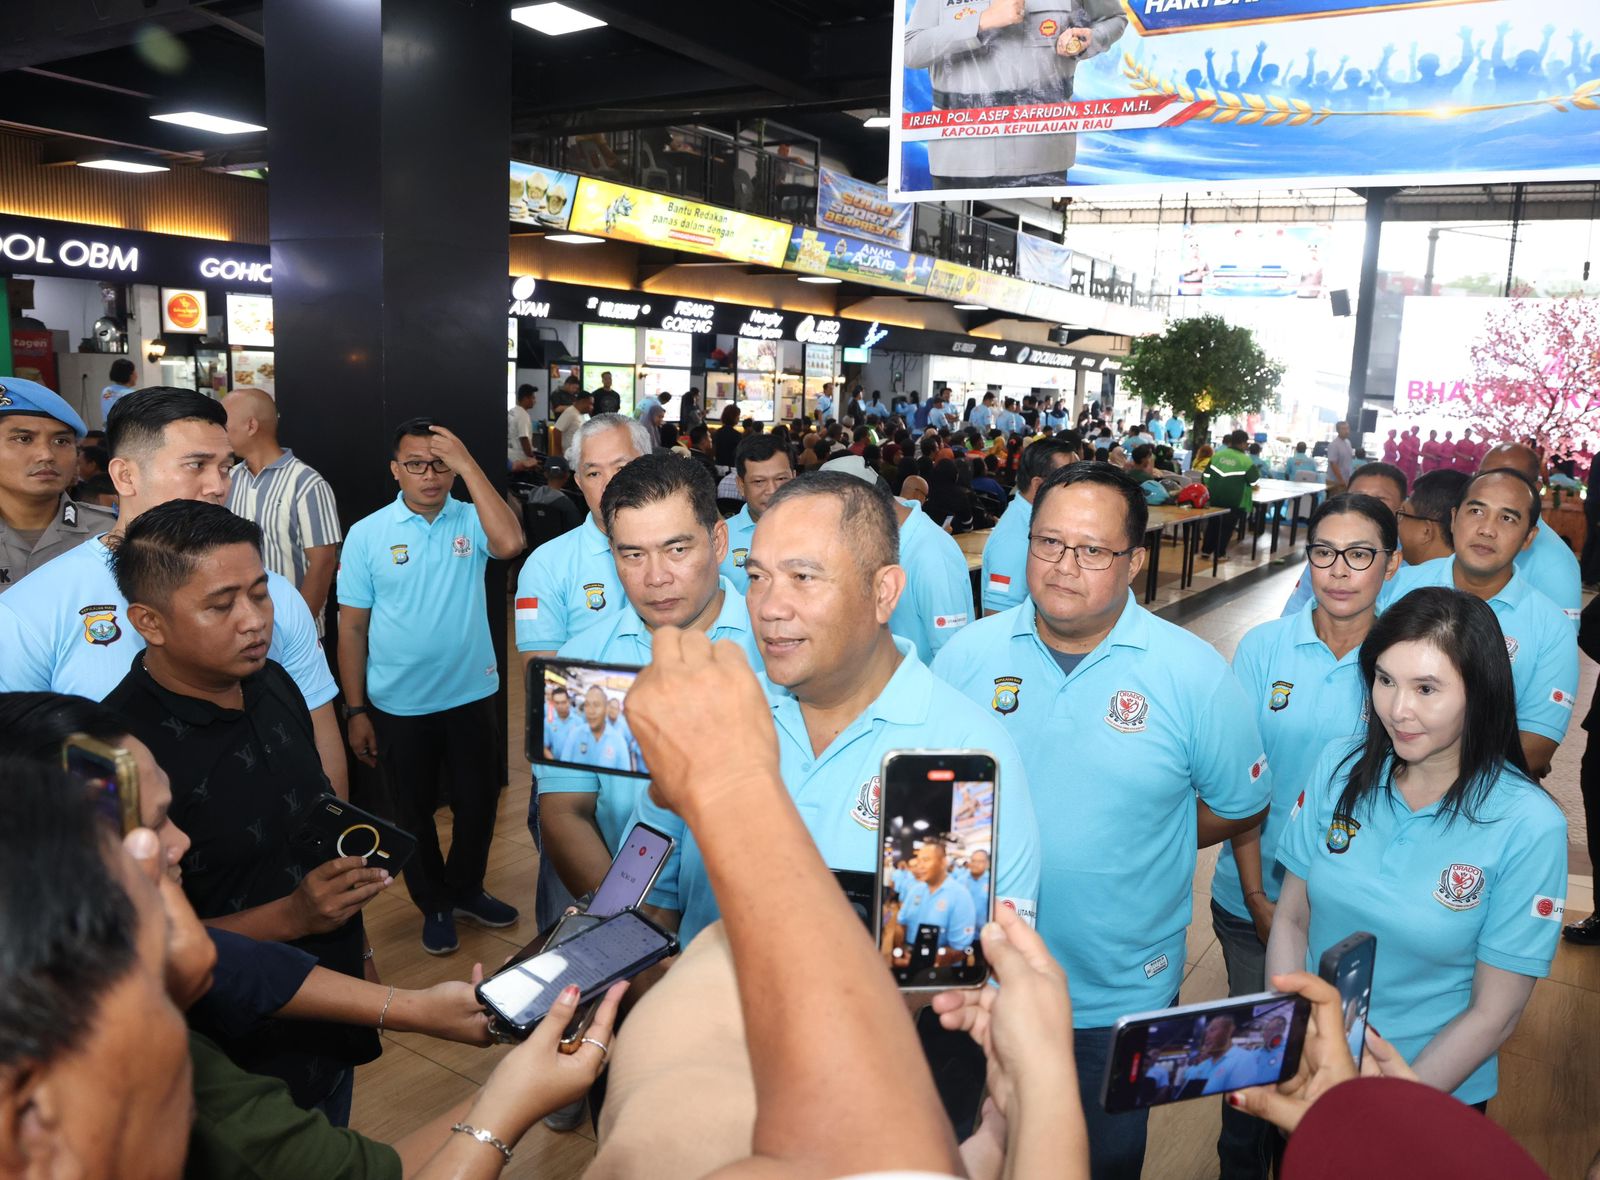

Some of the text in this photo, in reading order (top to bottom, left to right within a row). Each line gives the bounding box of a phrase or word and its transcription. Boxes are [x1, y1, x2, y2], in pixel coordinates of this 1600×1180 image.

[908, 113, 943, 127] IRJEN.
[946, 111, 974, 124] POL.
[977, 110, 1010, 122] ASEP
[1120, 99, 1152, 113] M.H.
[940, 118, 1113, 138] KAPOLDA KEPULAUAN RIAU
[667, 201, 728, 223] Bantu Redakan
[652, 214, 678, 227] panas
[680, 218, 705, 232] dalam
[706, 224, 735, 239] dengan
[0, 233, 139, 272] OL OBM
[851, 251, 896, 271] AJAIB
[861, 243, 893, 259] ANAK
[508, 300, 550, 318] AYAM
[661, 315, 713, 334] GORENG
[1452, 865, 1480, 876] ORADO
